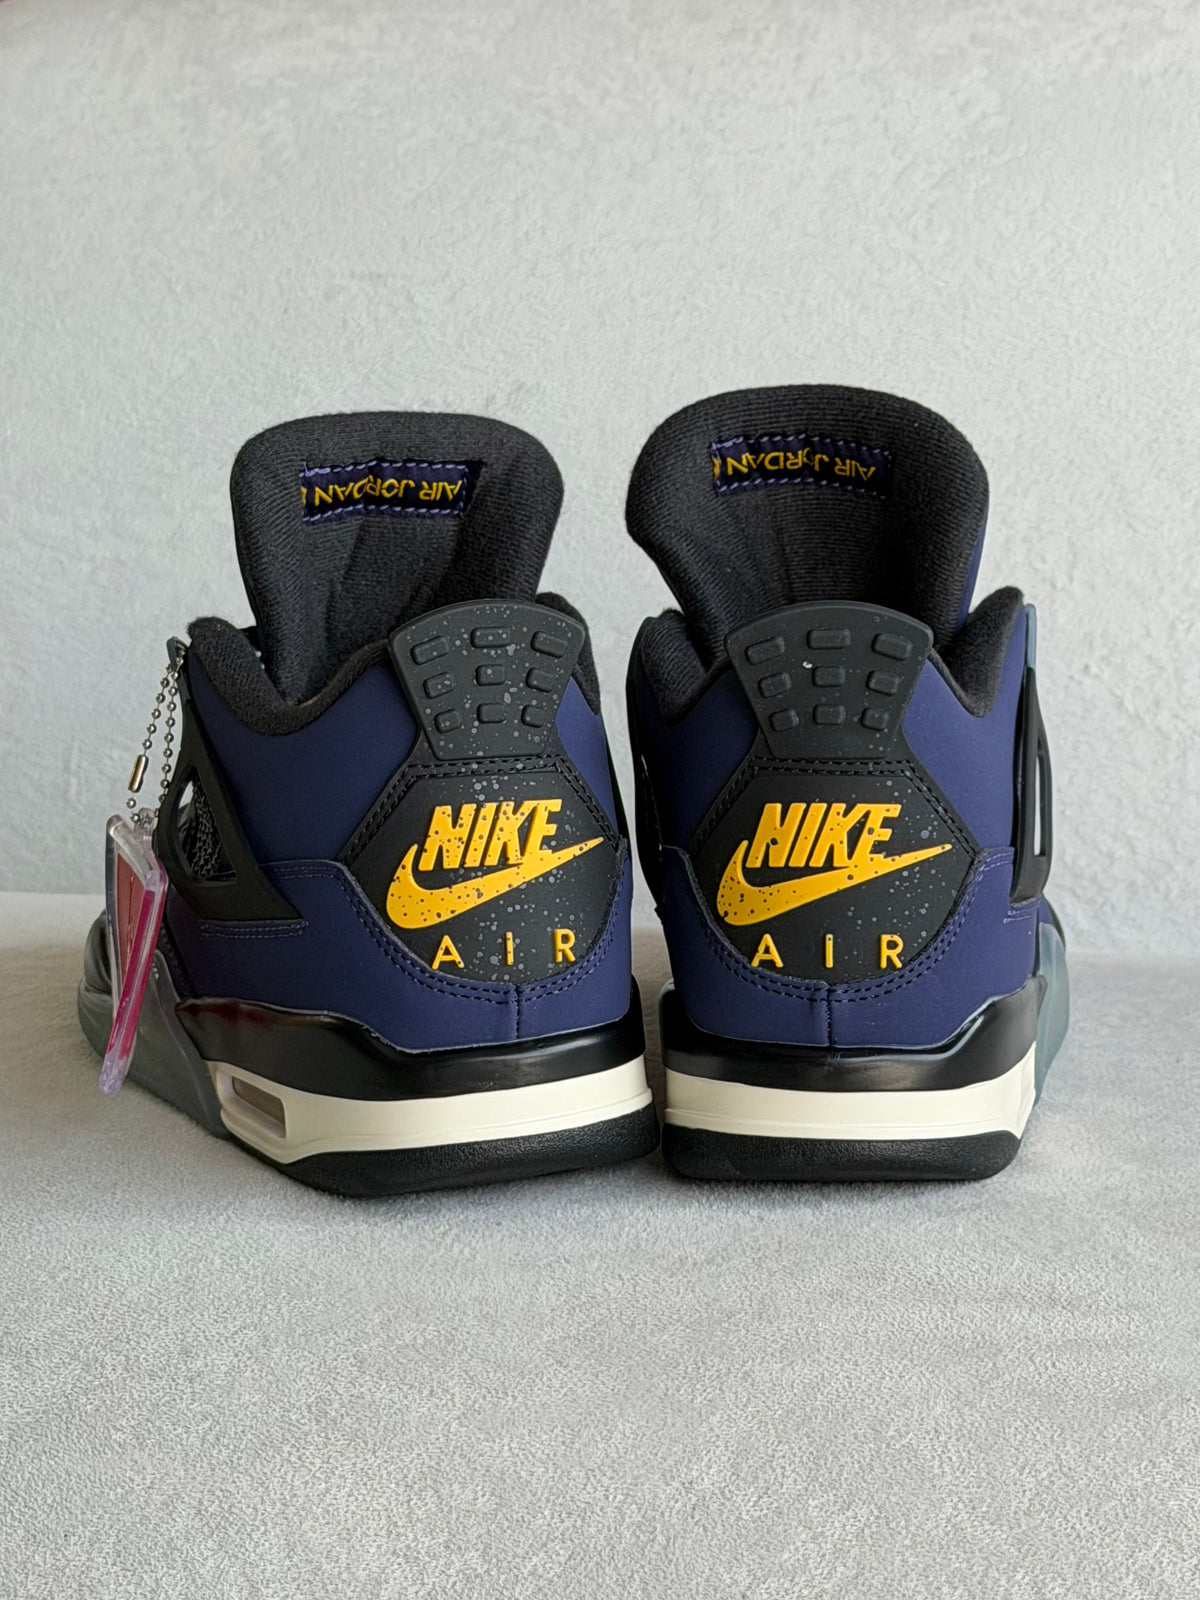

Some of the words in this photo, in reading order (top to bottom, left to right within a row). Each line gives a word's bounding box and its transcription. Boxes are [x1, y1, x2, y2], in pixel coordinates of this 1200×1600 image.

[834, 457, 876, 481] AIR
[314, 474, 415, 507] JORDAN
[419, 480, 462, 501] AIR
[418, 798, 563, 872] NIKE
[745, 802, 902, 868] NIKE
[431, 928, 576, 970] AIR
[750, 933, 905, 969] AIR
